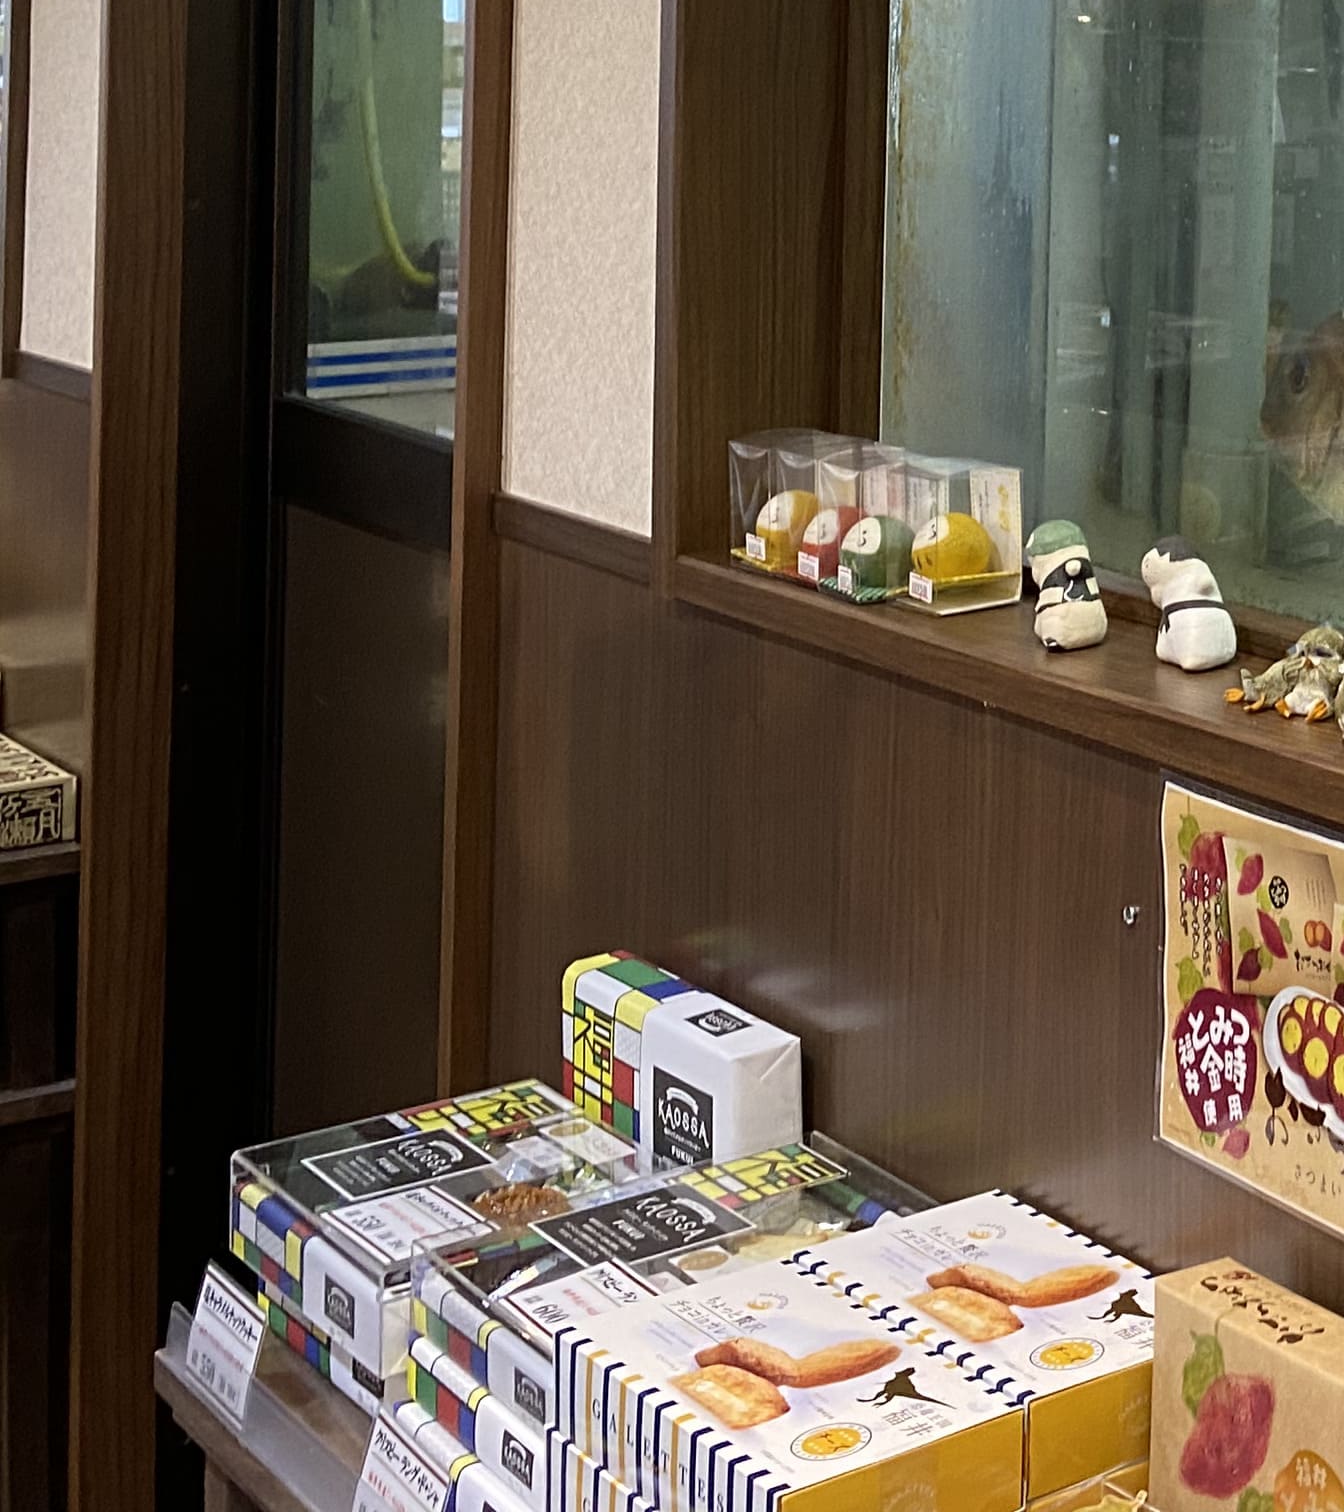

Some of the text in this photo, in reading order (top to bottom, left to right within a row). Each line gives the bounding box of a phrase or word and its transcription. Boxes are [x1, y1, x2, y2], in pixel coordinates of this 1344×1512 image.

[1188, 1005, 1250, 1051] とみつ
[1178, 1032, 1200, 1096] 福井
[1200, 1043, 1247, 1094] 金時
[658, 1097, 710, 1149] KAOSSA
[1203, 1093, 1243, 1126] 使用
[635, 1196, 707, 1243] KAOSSA
[533, 1303, 569, 1324] 600
